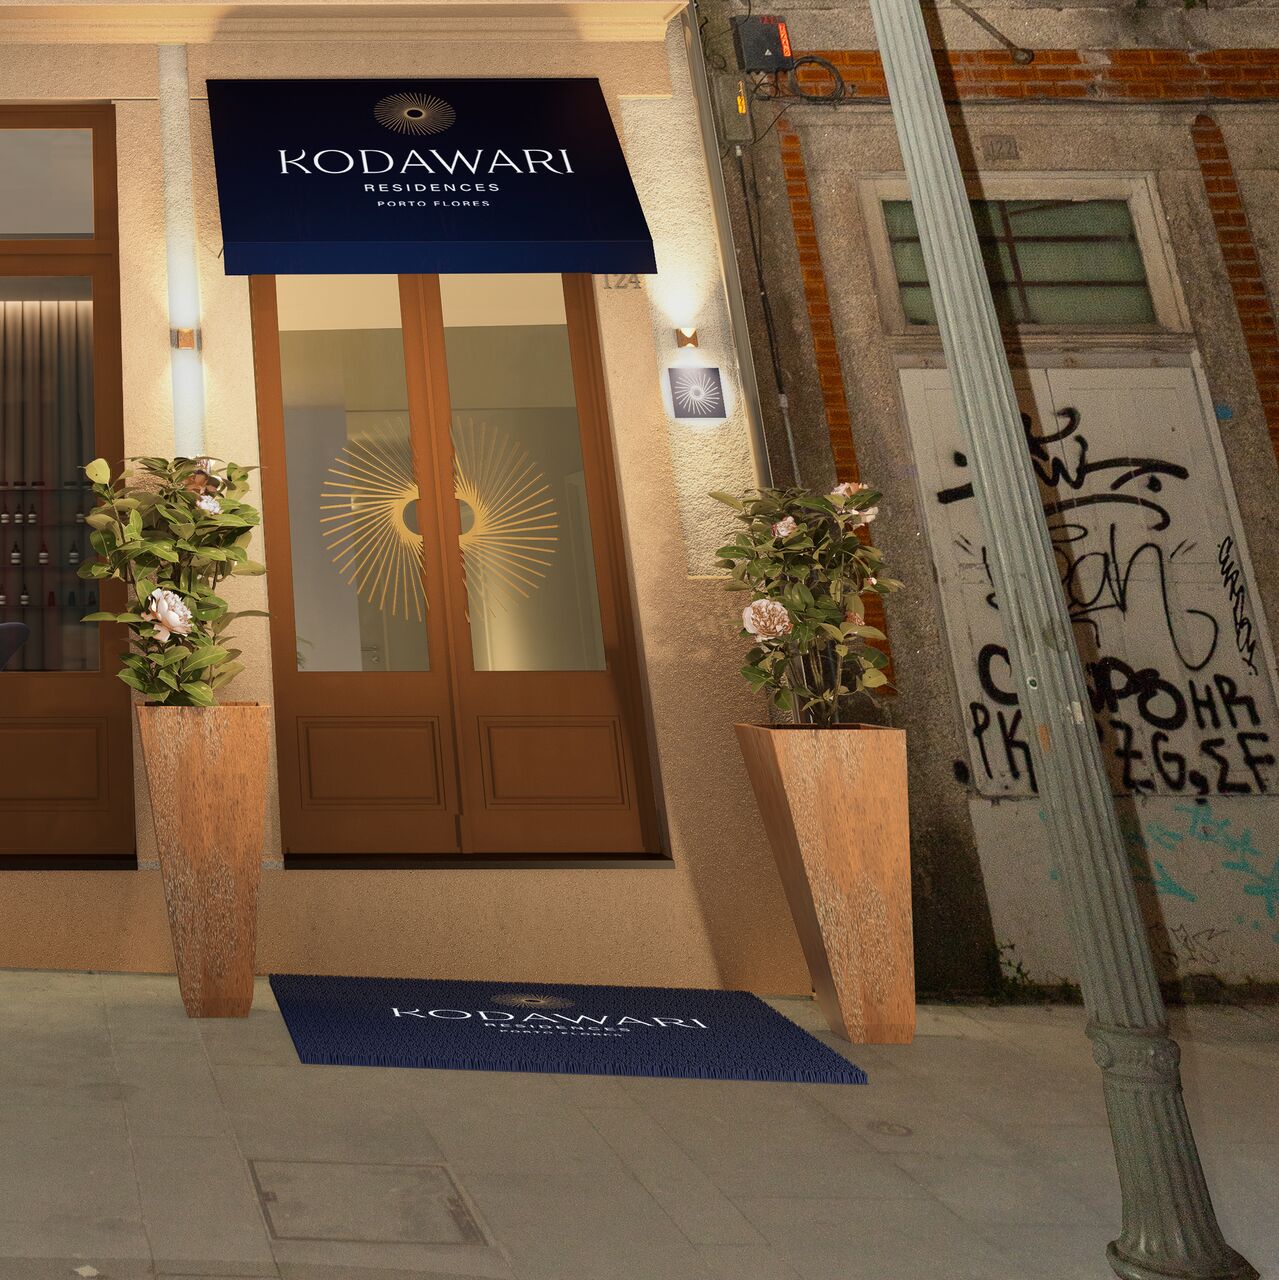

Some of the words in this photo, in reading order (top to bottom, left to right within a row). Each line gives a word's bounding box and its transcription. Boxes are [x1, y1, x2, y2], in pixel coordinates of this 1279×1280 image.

[278, 149, 575, 175] KODAWARI
[363, 183, 500, 192] RESIDENCES
[391, 1007, 710, 1029] KODAWARI
